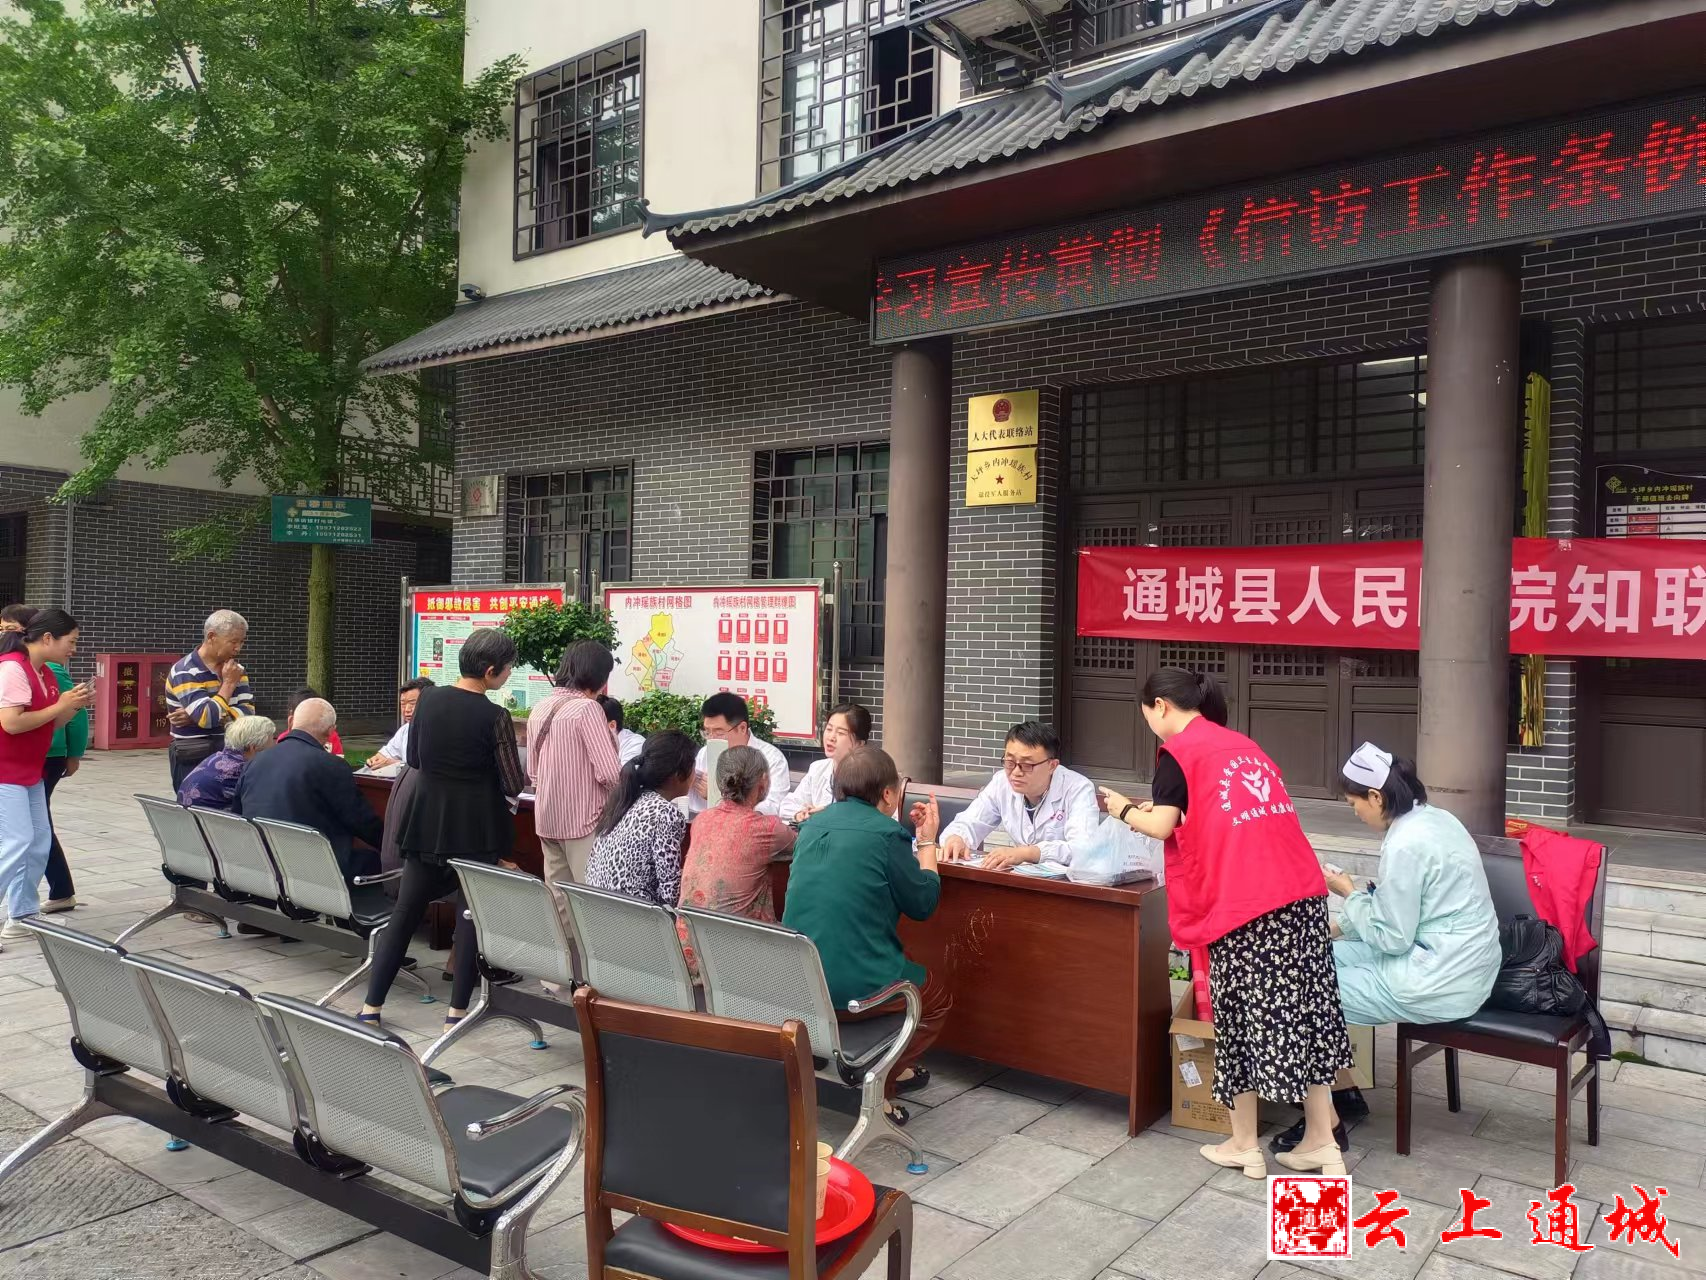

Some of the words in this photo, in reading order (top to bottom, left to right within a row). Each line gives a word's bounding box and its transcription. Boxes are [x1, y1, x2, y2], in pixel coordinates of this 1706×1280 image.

[973, 426, 1033, 441] 人大代表联络站
[427, 597, 481, 611] 抵御邪教侵害
[625, 595, 692, 609] 内冲瑶族村网格图
[1122, 564, 1706, 637] 通城县人民院知联
[156, 718, 166, 728] 119
